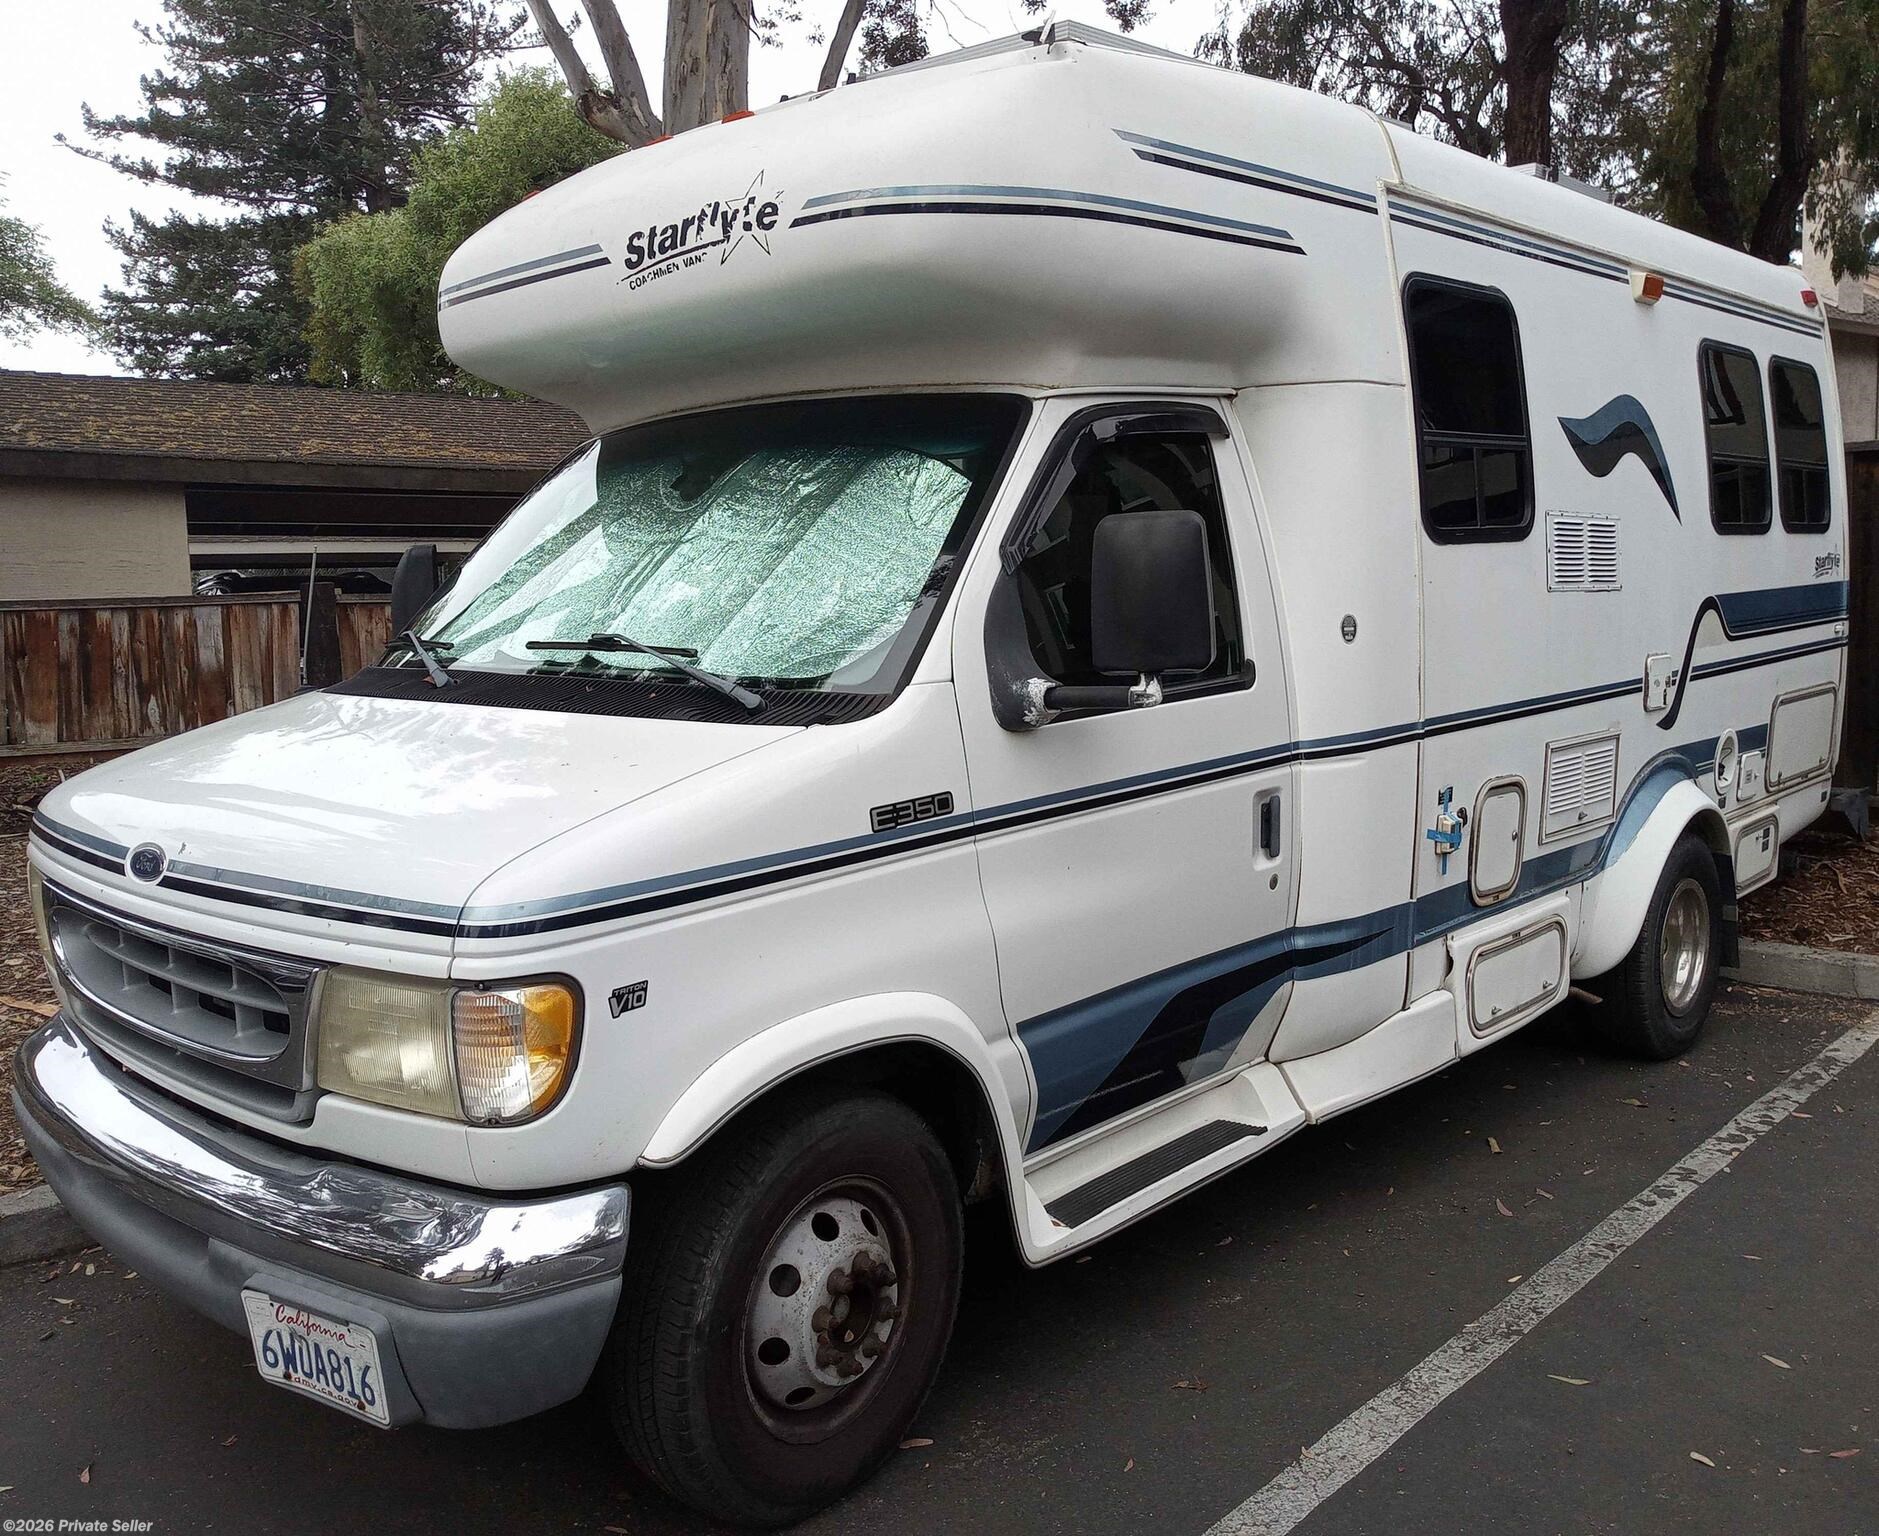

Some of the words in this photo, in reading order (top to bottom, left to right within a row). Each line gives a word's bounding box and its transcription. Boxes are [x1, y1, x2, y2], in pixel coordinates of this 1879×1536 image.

[629, 262, 680, 291] COACHMEN
[610, 991, 646, 1017] V10
[275, 1304, 355, 1348] California
